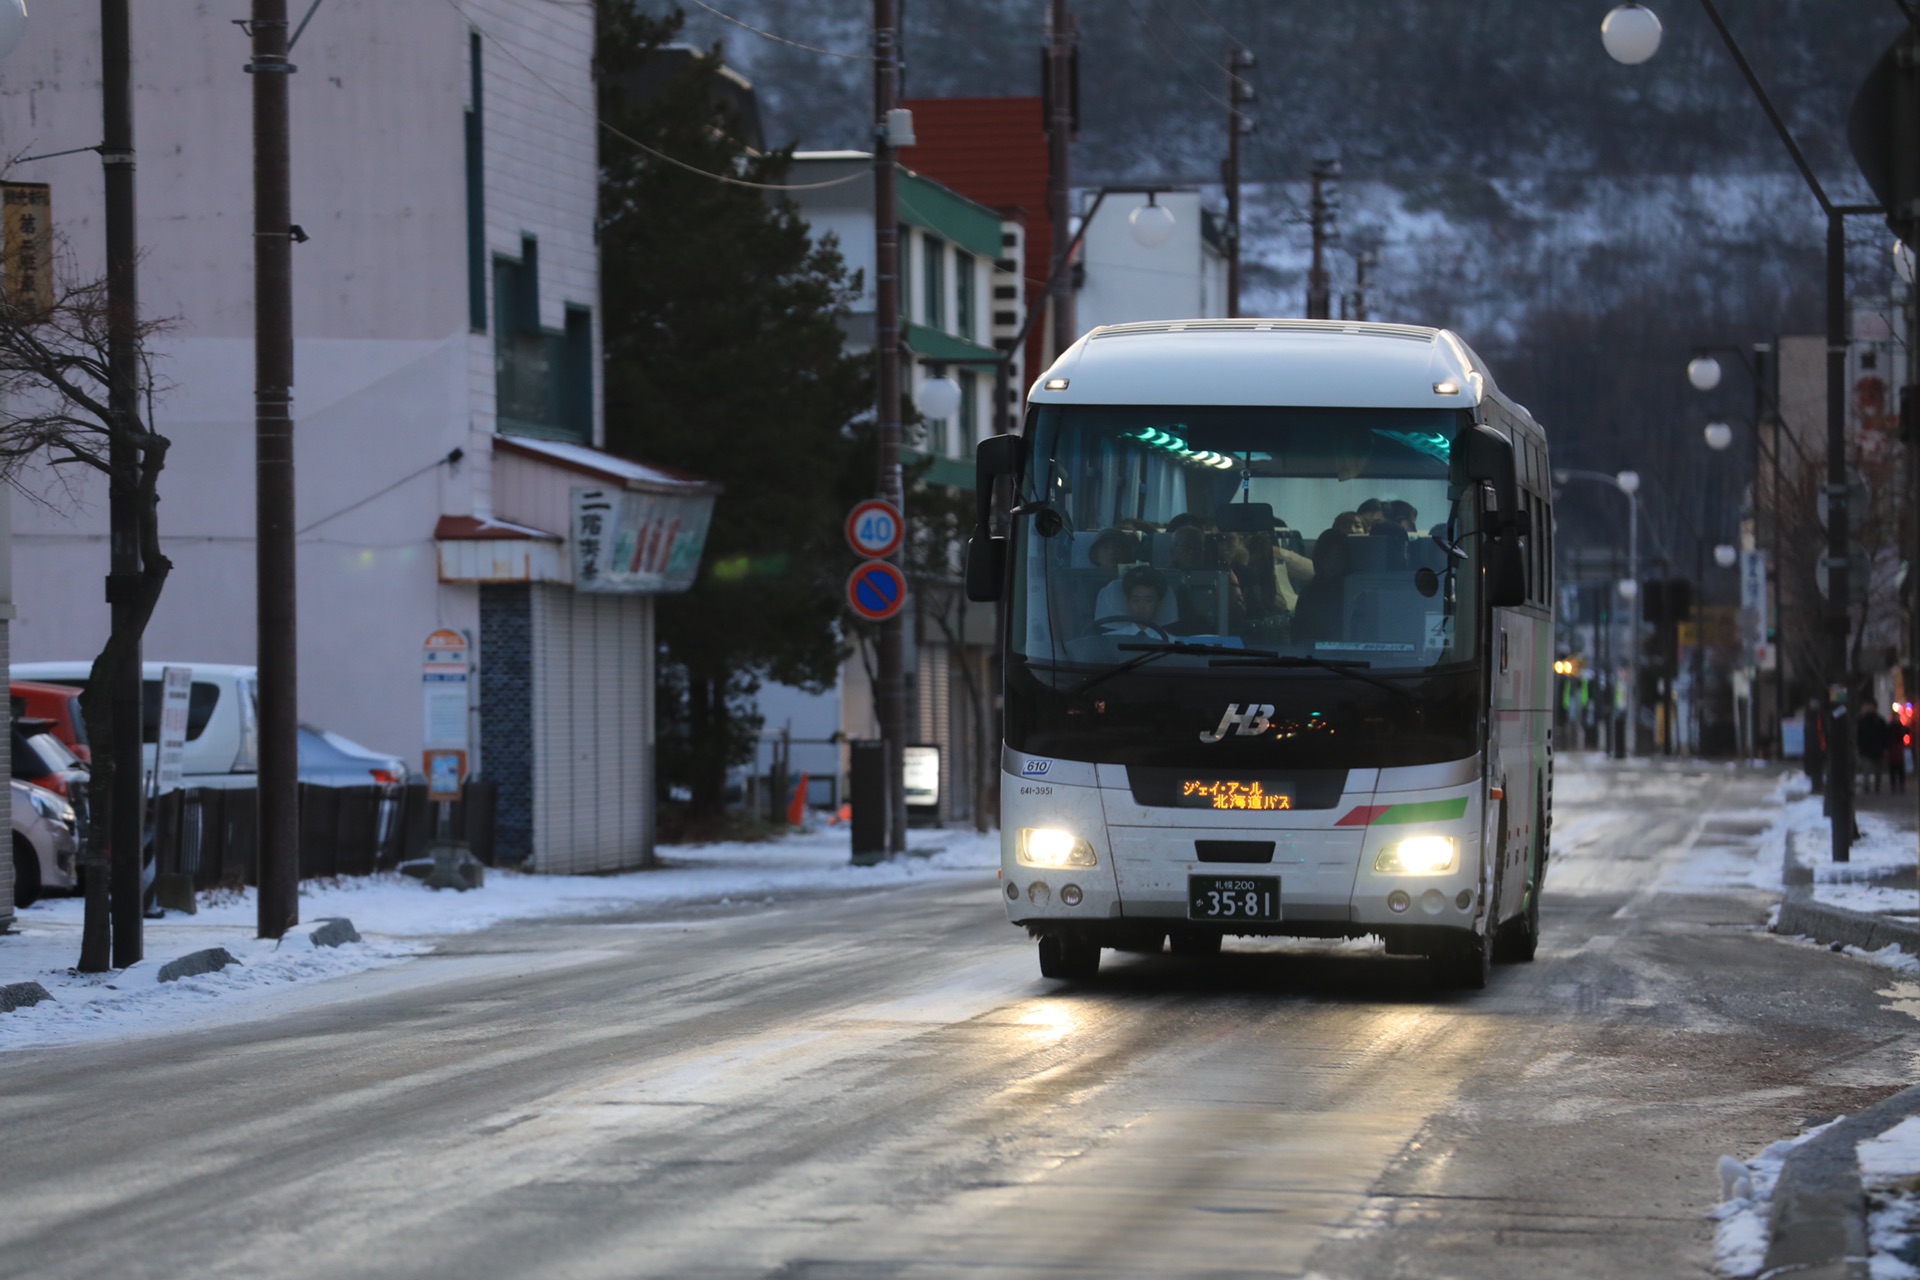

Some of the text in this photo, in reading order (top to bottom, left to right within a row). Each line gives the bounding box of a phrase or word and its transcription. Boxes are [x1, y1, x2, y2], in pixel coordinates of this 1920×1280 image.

[859, 516, 893, 543] 40
[1430, 616, 1449, 637] 4
[1027, 761, 1047, 771] 610
[1020, 787, 1053, 795] 641-3951
[1183, 780, 1263, 797] ジェイ・アール
[1213, 794, 1291, 810] 北海道バス
[1215, 880, 1255, 890] 札幌 200
[1207, 890, 1271, 917] 35-81
